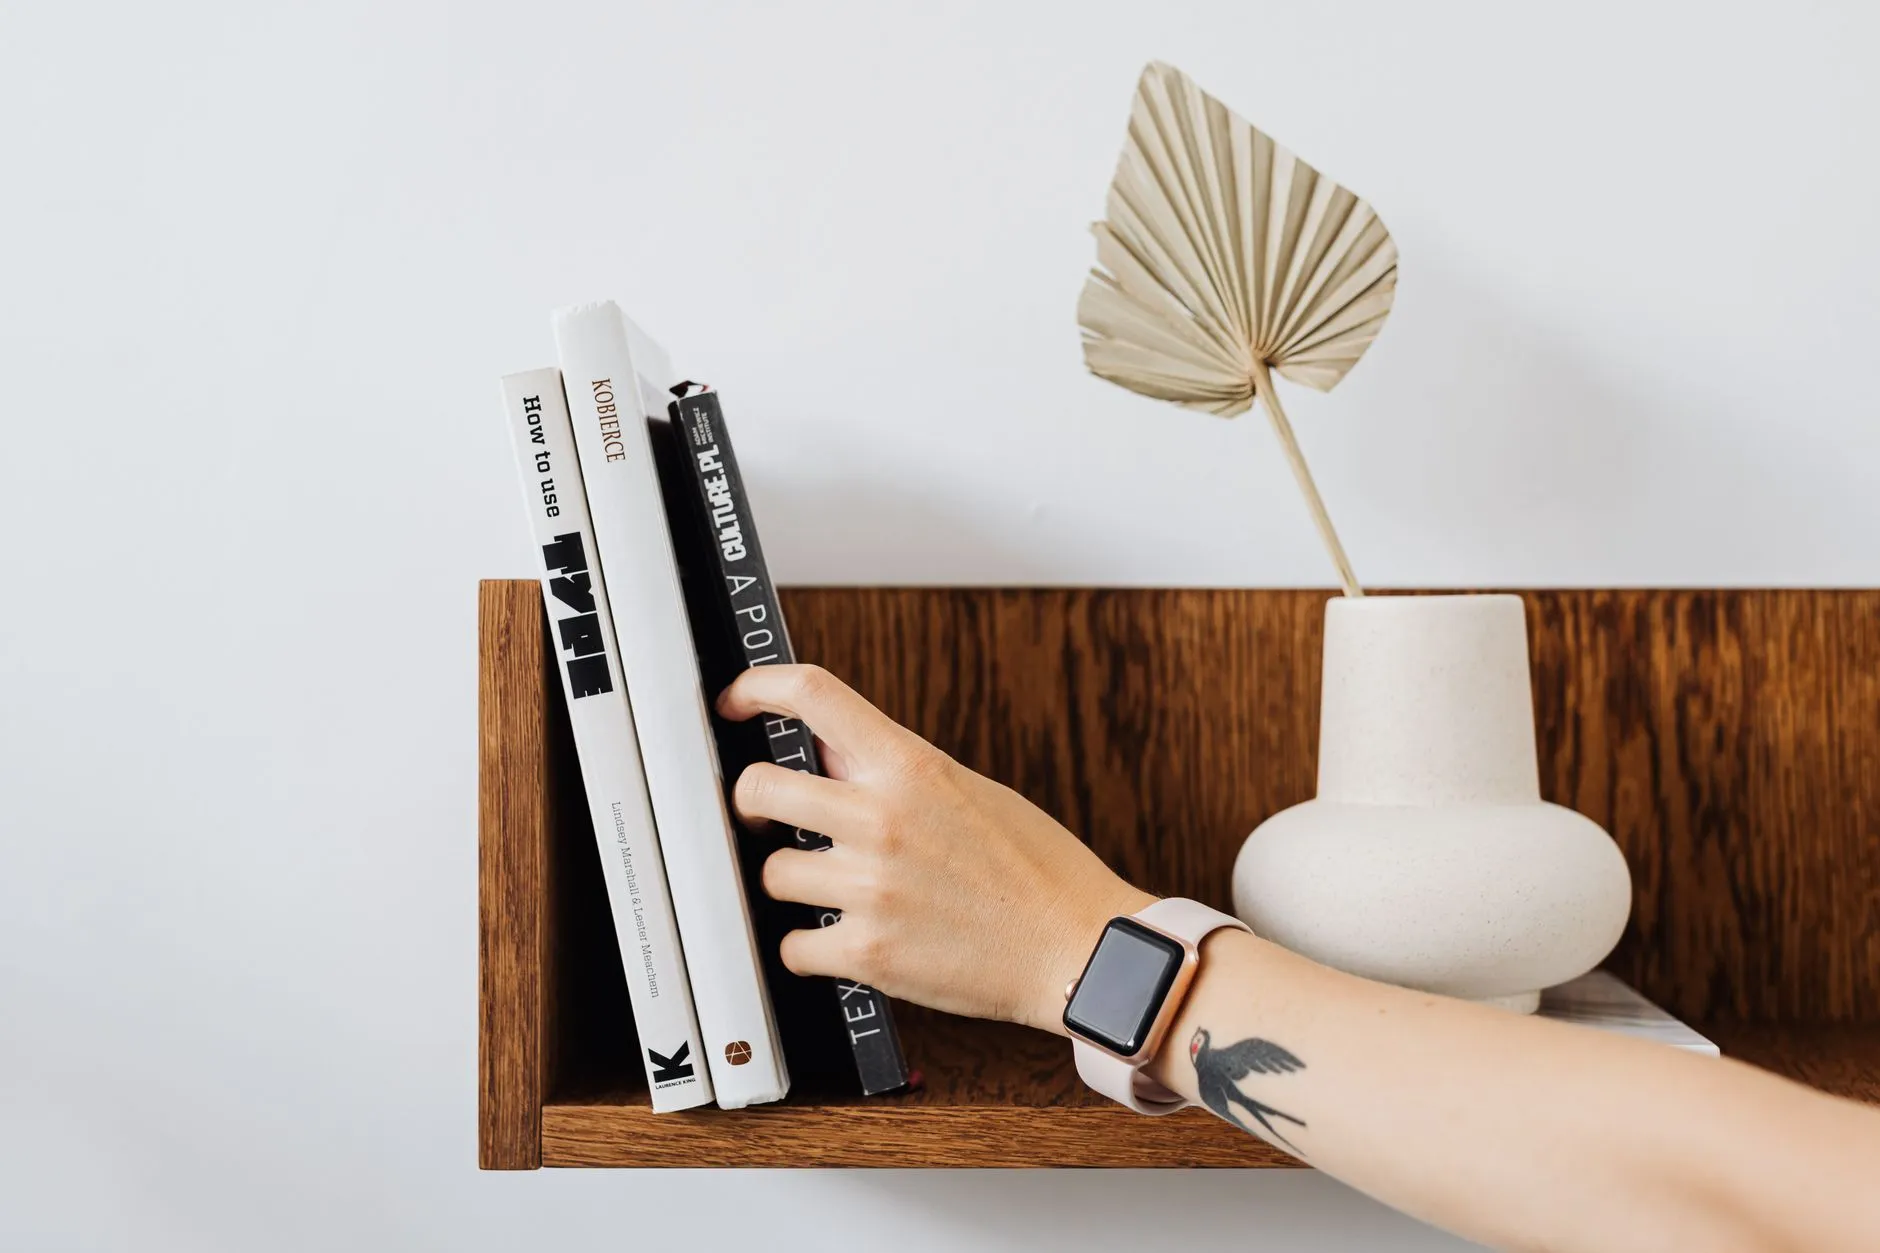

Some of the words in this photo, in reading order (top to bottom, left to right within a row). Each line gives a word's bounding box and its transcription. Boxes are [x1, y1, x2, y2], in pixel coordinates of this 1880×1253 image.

[523, 395, 545, 445] How
[591, 378, 626, 463] KOBIERCE
[535, 450, 551, 473] to
[540, 478, 560, 518] use
[697, 444, 747, 562] CULTURE.PL
[726, 575, 758, 596] A
[542, 531, 614, 699] TYPE
[611, 801, 628, 845] Lindsey
[621, 847, 640, 896] Marshall
[631, 896, 642, 905] &
[633, 904, 648, 942] Lester
[641, 943, 660, 998] Meachem
[655, 1080, 682, 1090] LAURENCE
[682, 1077, 697, 1086] KING
